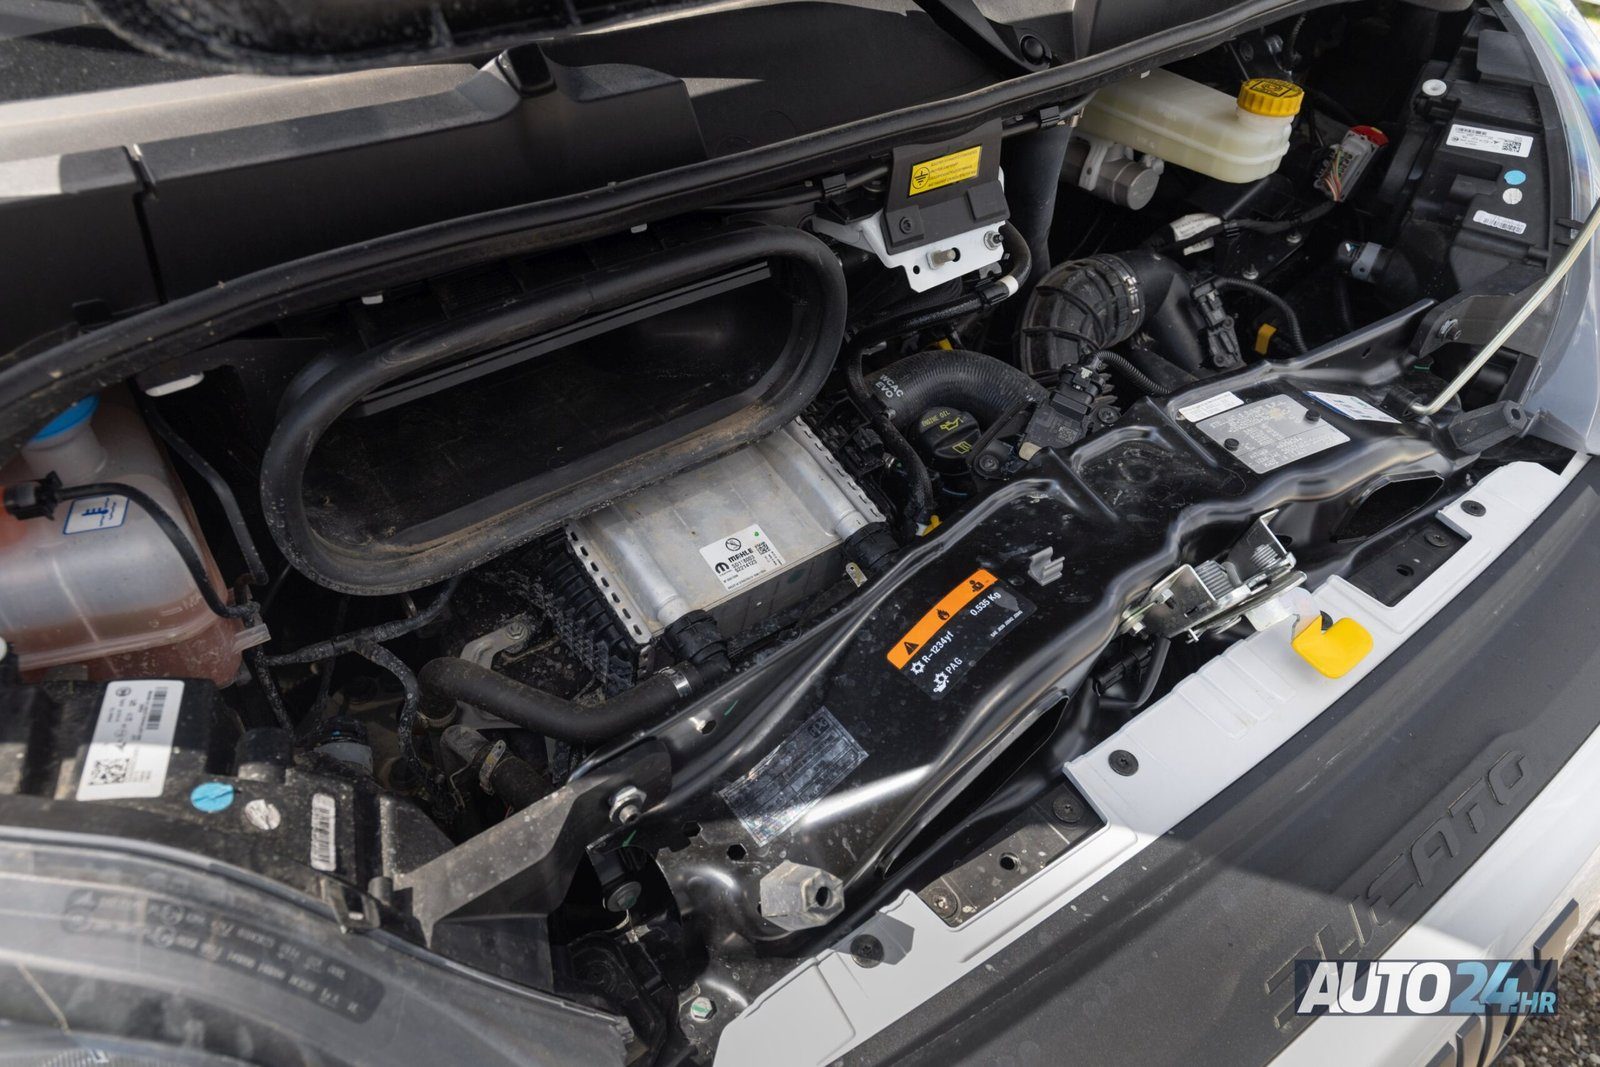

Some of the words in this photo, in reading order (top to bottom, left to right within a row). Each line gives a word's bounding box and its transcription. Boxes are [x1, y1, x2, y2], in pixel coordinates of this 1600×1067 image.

[876, 382, 894, 398] EVO
[728, 548, 754, 562] MAHLE
[922, 630, 954, 663] R-1234yf
[970, 599, 990, 616] 0.535
[988, 592, 1002, 602] Kg
[945, 658, 962, 674] PAG
